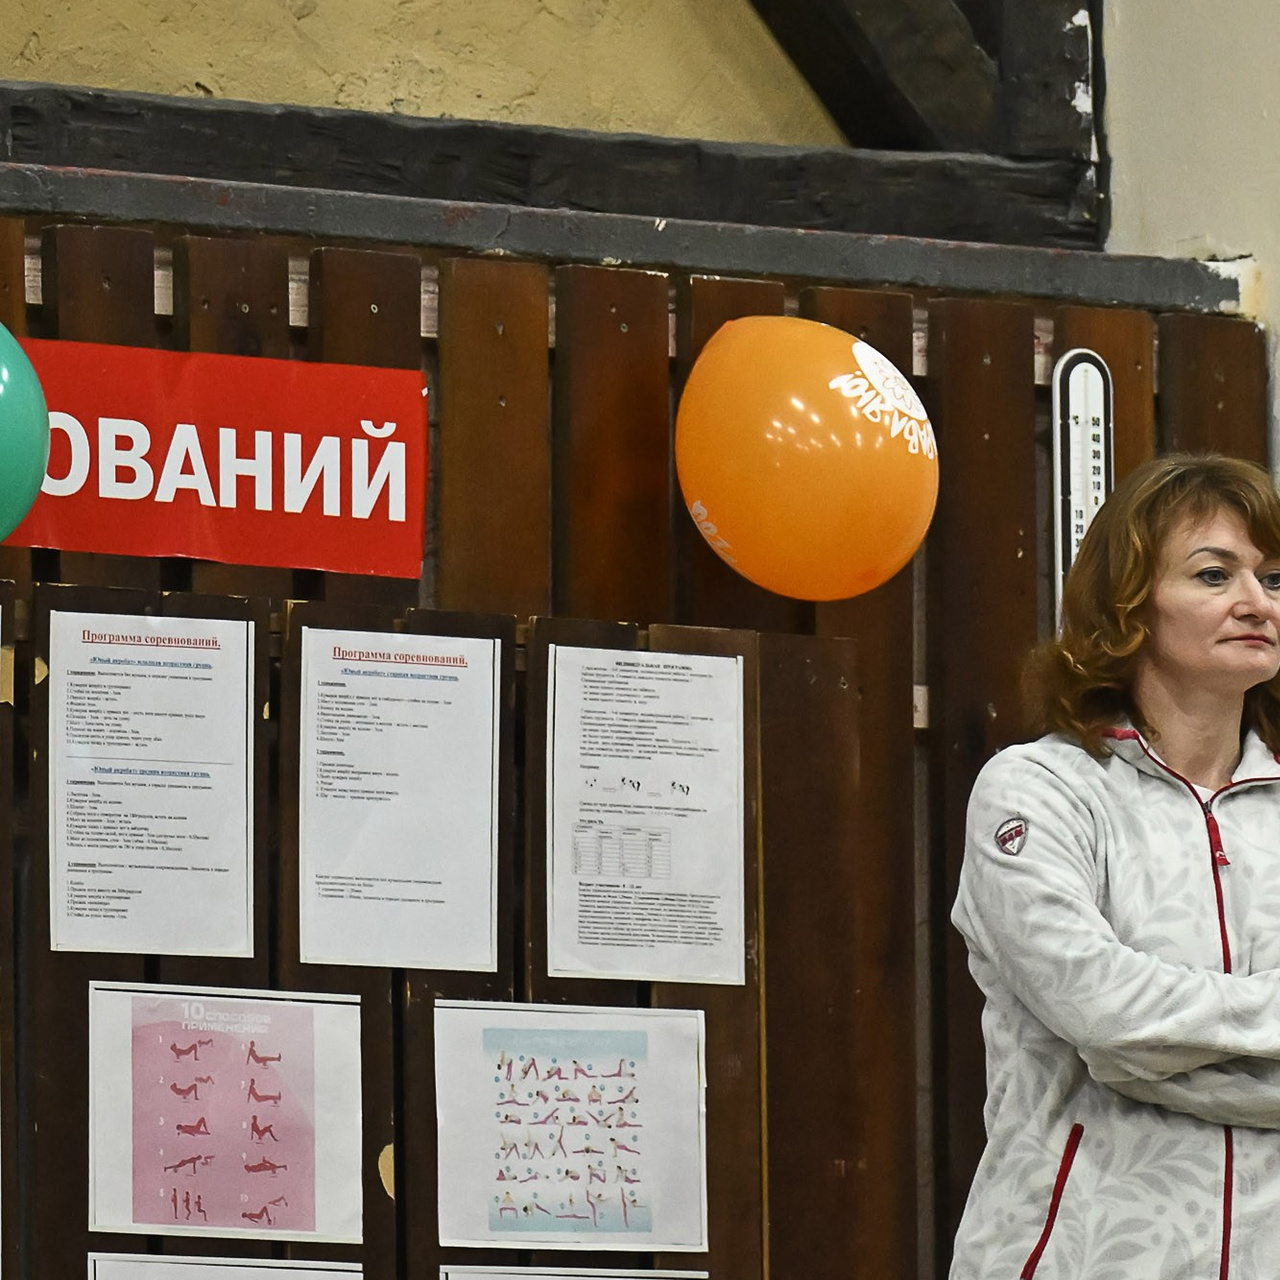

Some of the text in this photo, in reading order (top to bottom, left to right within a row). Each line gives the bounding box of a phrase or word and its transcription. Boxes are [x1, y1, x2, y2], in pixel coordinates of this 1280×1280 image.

[1092, 417, 1100, 427] 50
[1092, 433, 1100, 443] 40
[1092, 450, 1101, 460] 30
[41, 411, 406, 522] ОВАНИЙ
[1092, 466, 1101, 475] 20
[1092, 481, 1101, 491] 10
[1075, 509, 1083, 519] 10
[1075, 524, 1084, 533] 20
[82, 629, 221, 649] Программа соревнований.
[333, 646, 468, 667] Программа соревнований.
[181, 1002, 205, 1020] 10
